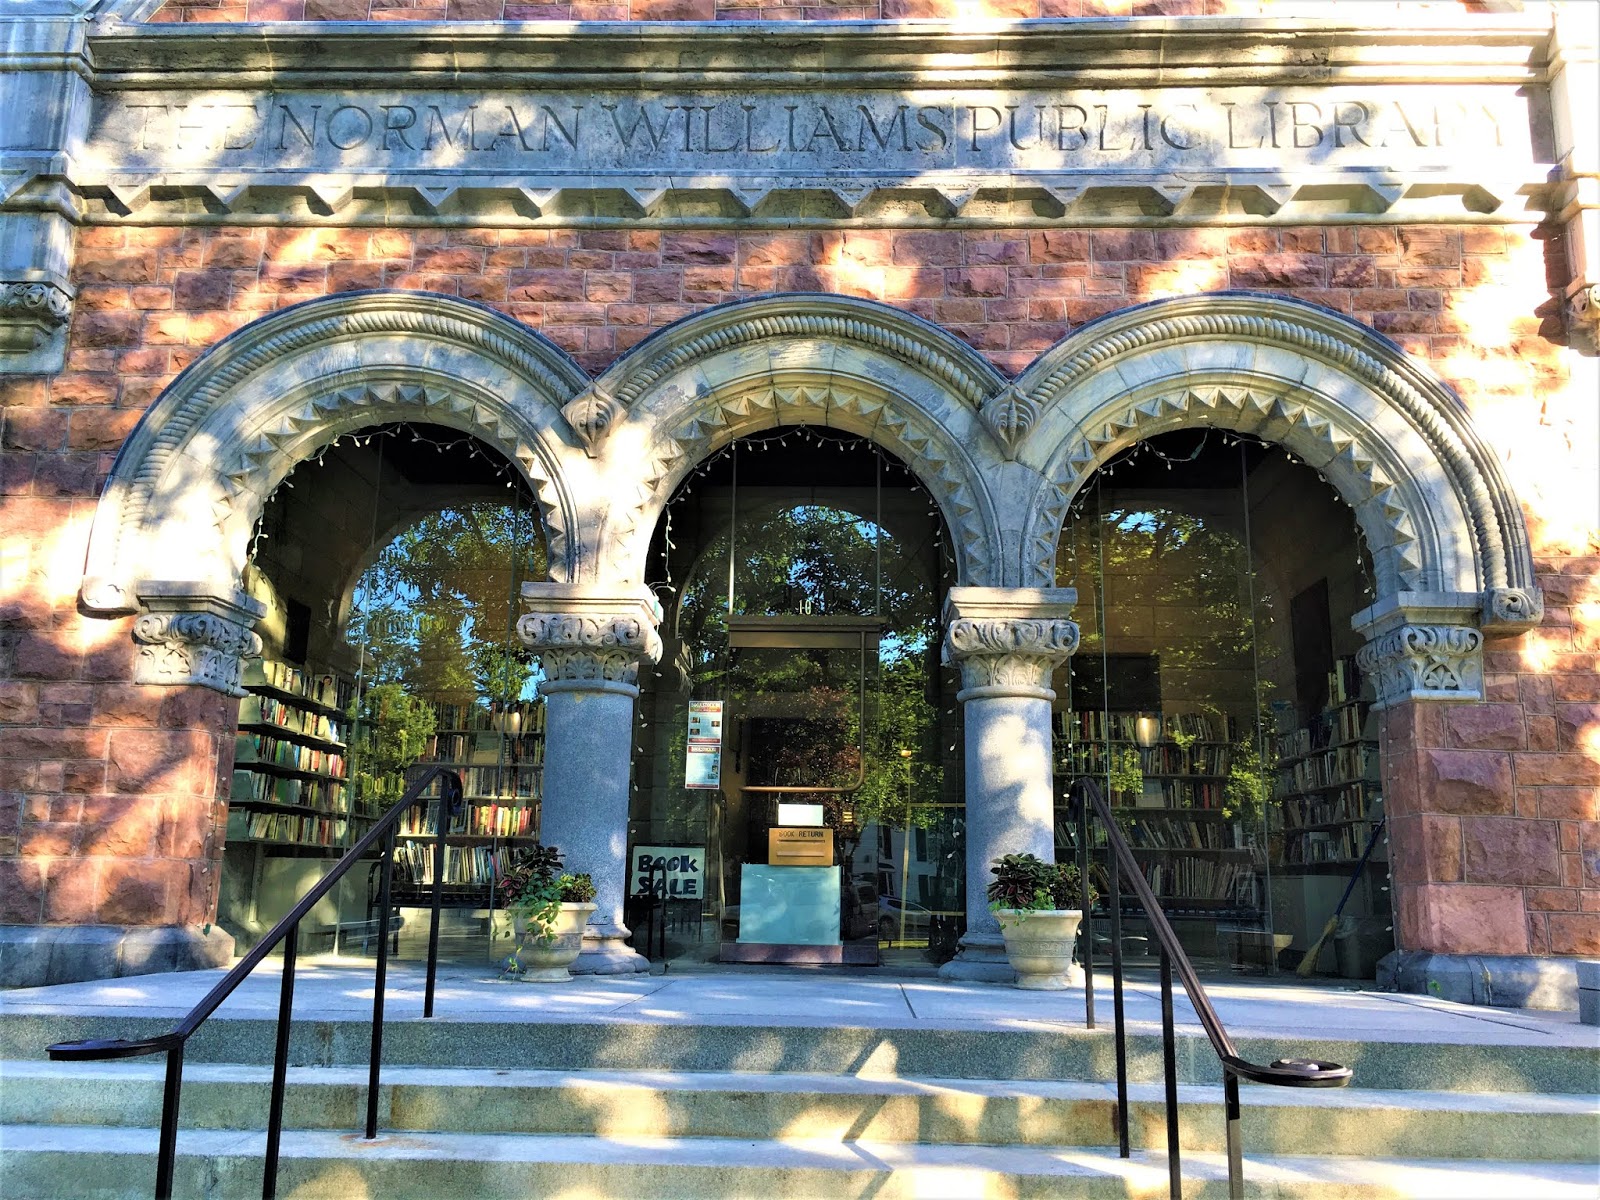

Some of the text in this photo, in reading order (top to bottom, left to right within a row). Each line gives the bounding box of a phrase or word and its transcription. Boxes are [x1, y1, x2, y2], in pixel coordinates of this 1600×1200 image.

[125, 103, 259, 151] THE
[277, 104, 585, 152] NORMAN
[602, 104, 948, 153] WILLIAMS
[966, 102, 1203, 152] PUBLIC
[799, 599, 812, 615] 10
[778, 830, 824, 838] BOOK RETURN
[637, 854, 699, 873] BOOK
[635, 876, 697, 895] SALE
